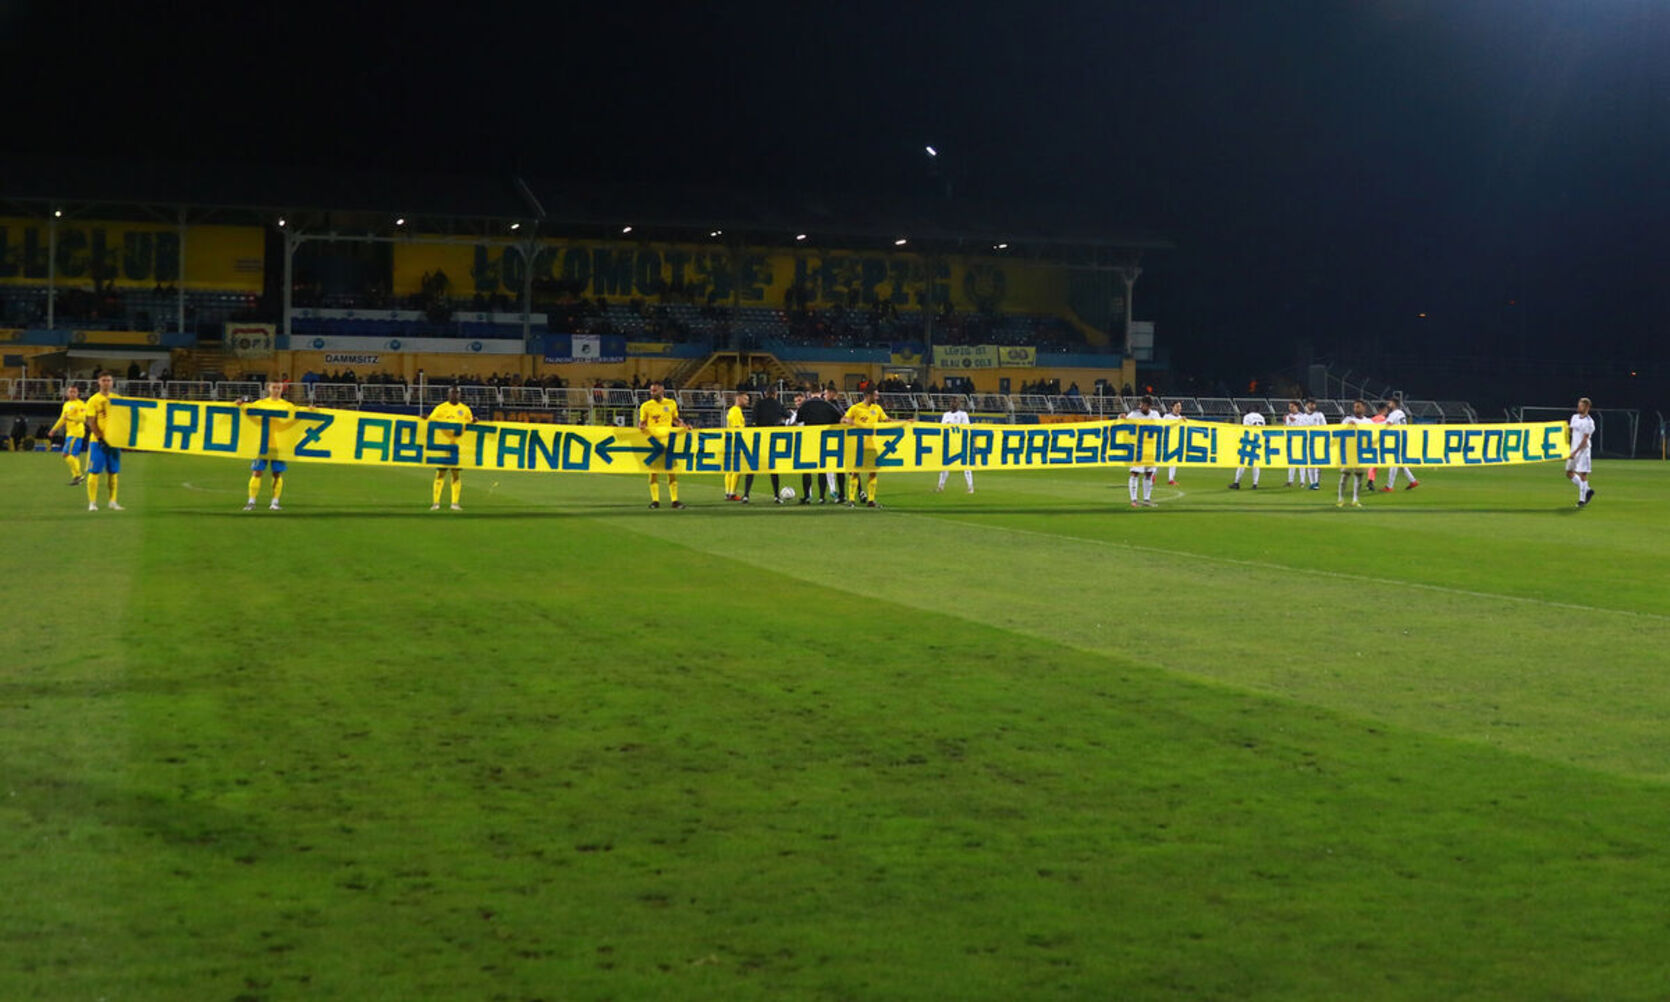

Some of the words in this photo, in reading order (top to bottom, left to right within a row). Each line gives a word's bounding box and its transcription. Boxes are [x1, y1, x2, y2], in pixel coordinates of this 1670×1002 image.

[325, 354, 379, 364] DAMMSITZ
[110, 397, 336, 459] TROTZ
[354, 417, 592, 470] ABSTAND
[768, 427, 906, 471] PLATZ
[911, 425, 995, 467] FÜR
[1237, 425, 1564, 467] #FOOTBALLPEOPLE
